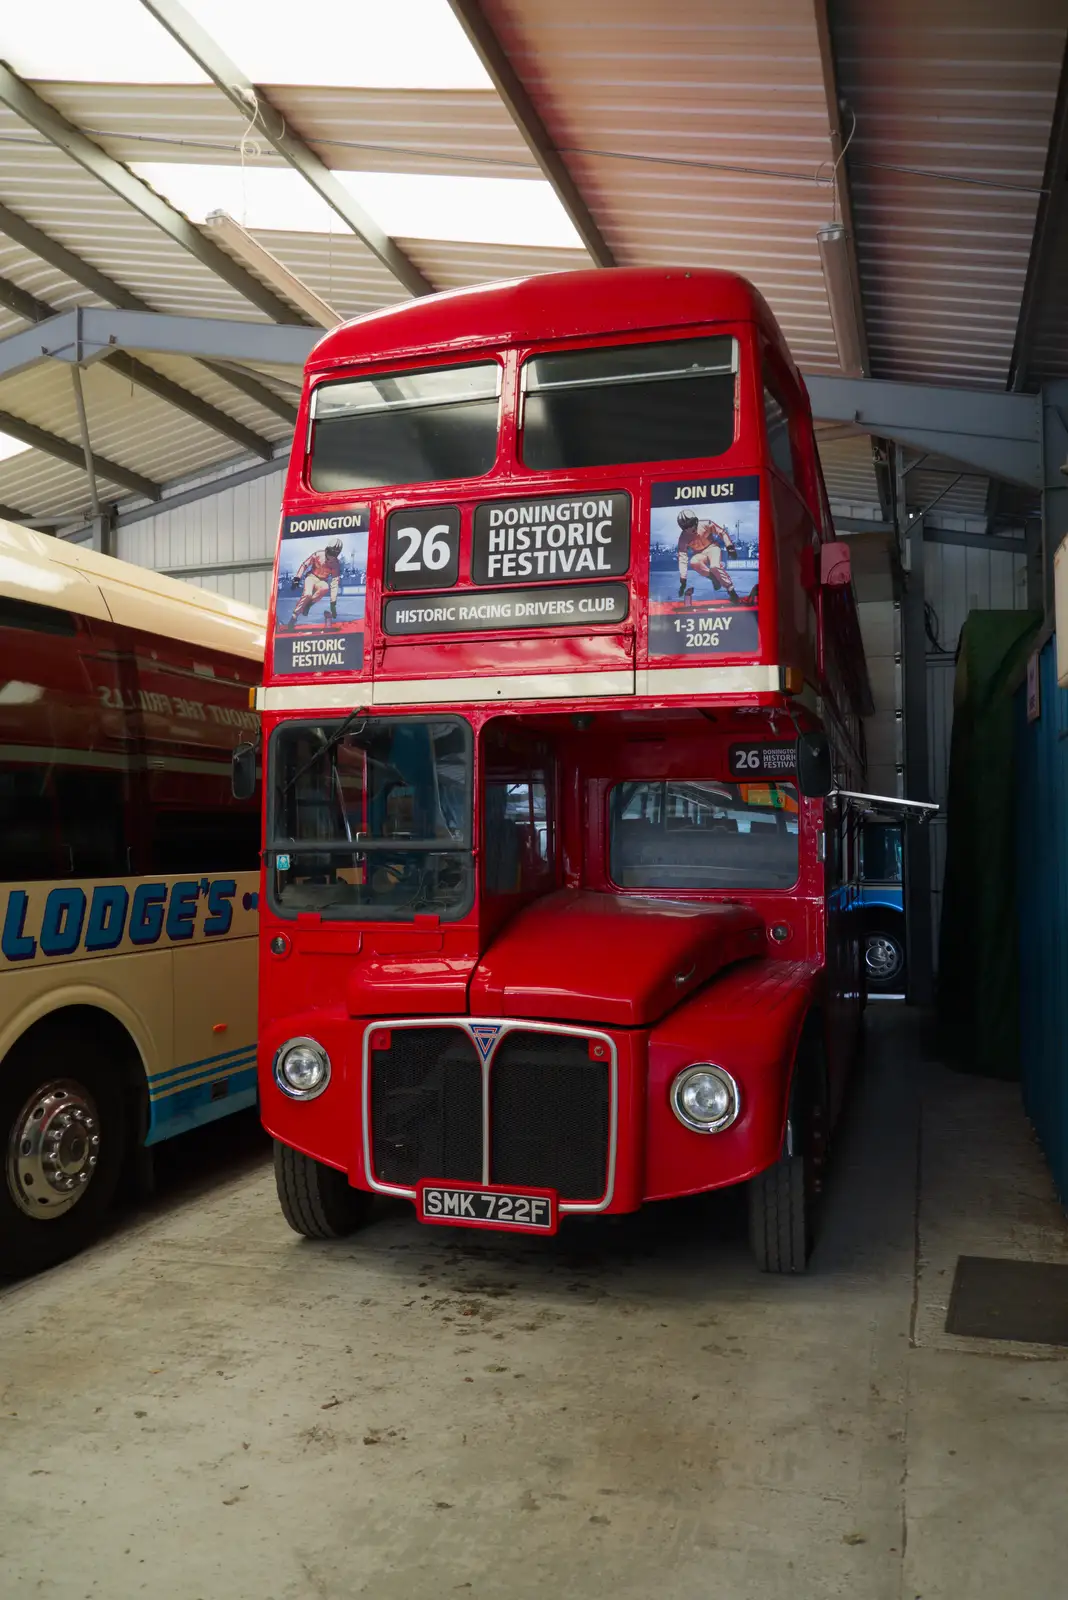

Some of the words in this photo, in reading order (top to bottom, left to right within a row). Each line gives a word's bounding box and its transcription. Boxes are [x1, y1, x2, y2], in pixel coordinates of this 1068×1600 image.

[674, 485, 707, 500] JOIN
[710, 483, 734, 497] US!
[489, 500, 613, 527] DONINGTON
[289, 515, 361, 533] DONINGTON
[488, 520, 612, 552] HISTORIC
[394, 525, 451, 572] 26
[487, 547, 611, 578] FESTIVAL
[395, 606, 456, 624] HISTORIC
[458, 603, 511, 621] RACING
[515, 600, 574, 617] DRIVERS
[578, 597, 615, 613] CLUB
[673, 618, 695, 633] 1-3
[699, 616, 733, 631] MAY
[292, 638, 346, 654] HISTORIC
[685, 632, 720, 647] 2026
[292, 653, 345, 667] FESTIVAL
[735, 750, 760, 769] 26
[763, 761, 796, 769] FESTIVA
[1, 877, 237, 962] LODGE'S
[427, 1191, 476, 1216] SMK
[481, 1195, 546, 1223] 722F
